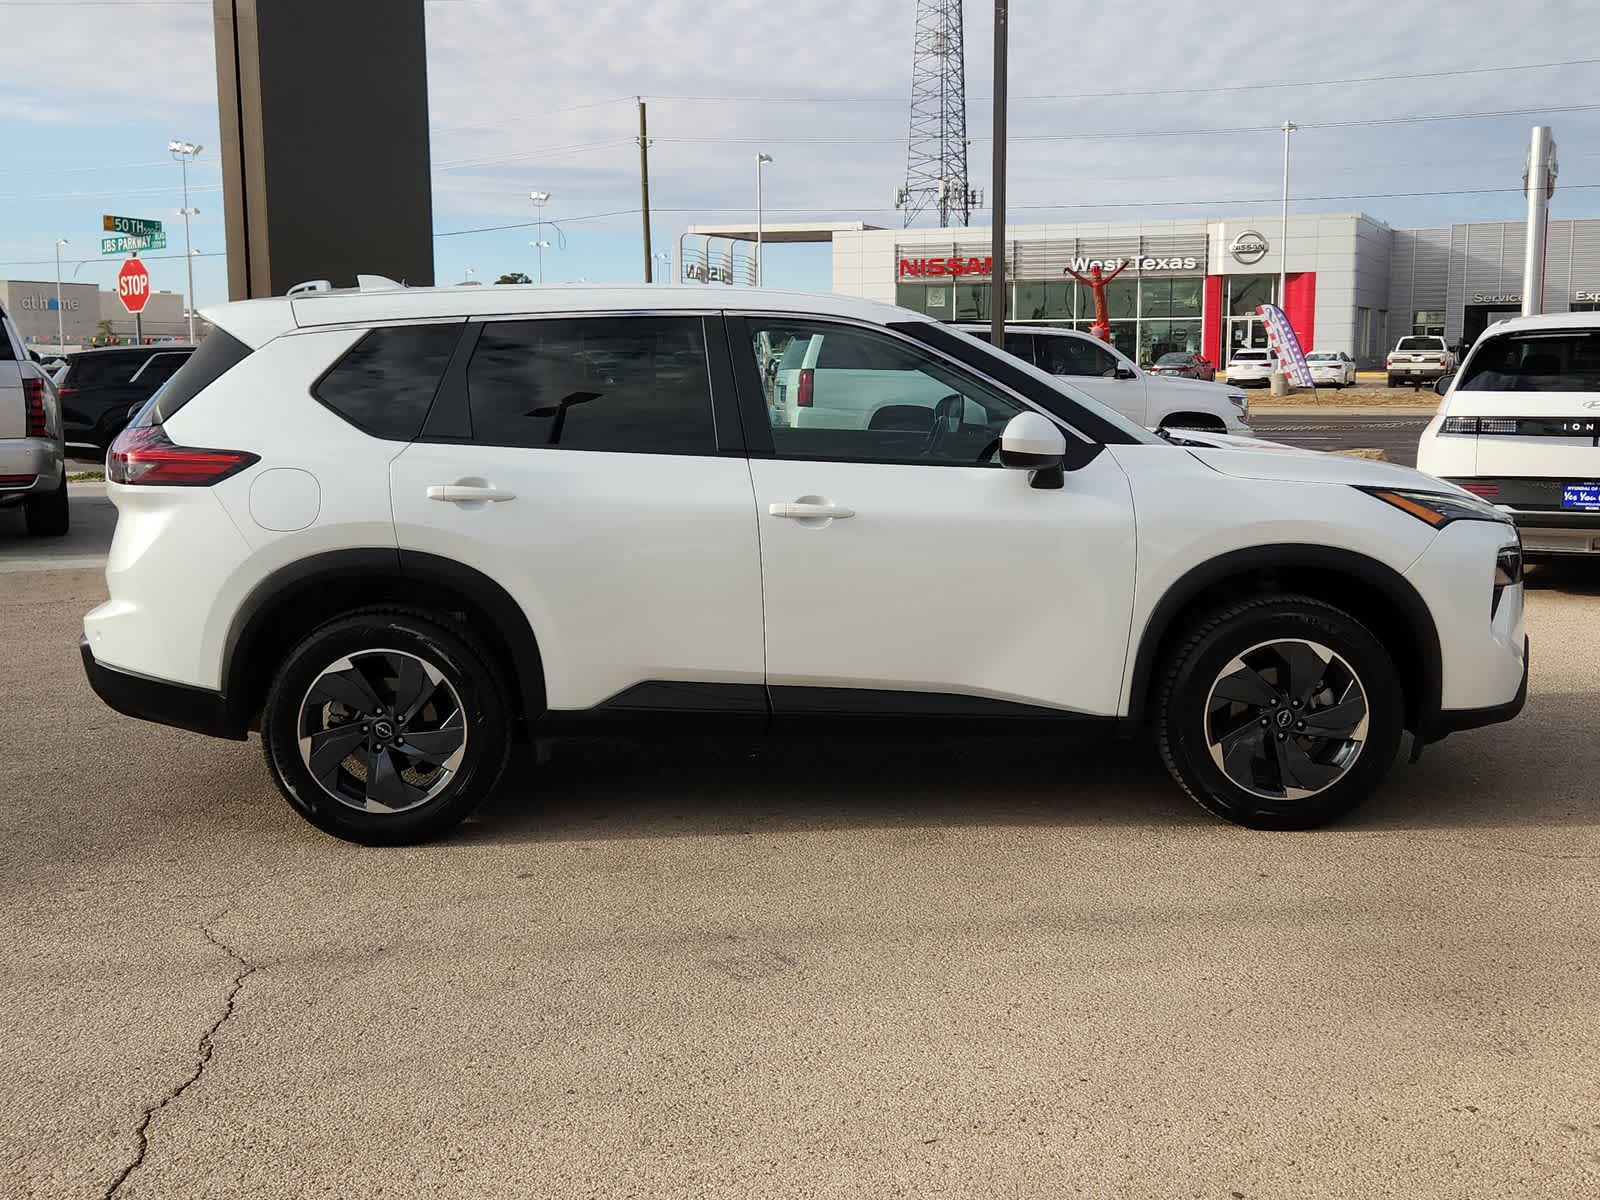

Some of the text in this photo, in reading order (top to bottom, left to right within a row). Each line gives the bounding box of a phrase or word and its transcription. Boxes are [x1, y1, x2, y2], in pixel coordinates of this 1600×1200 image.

[115, 218, 129, 231] 50
[131, 219, 144, 233] TH
[102, 239, 116, 252] JBS
[118, 234, 152, 251] PARKWAY
[1232, 243, 1265, 251] NISSAN
[1131, 255, 1197, 270] Texas
[120, 274, 147, 297] STOP
[1563, 423, 1594, 431] ION
